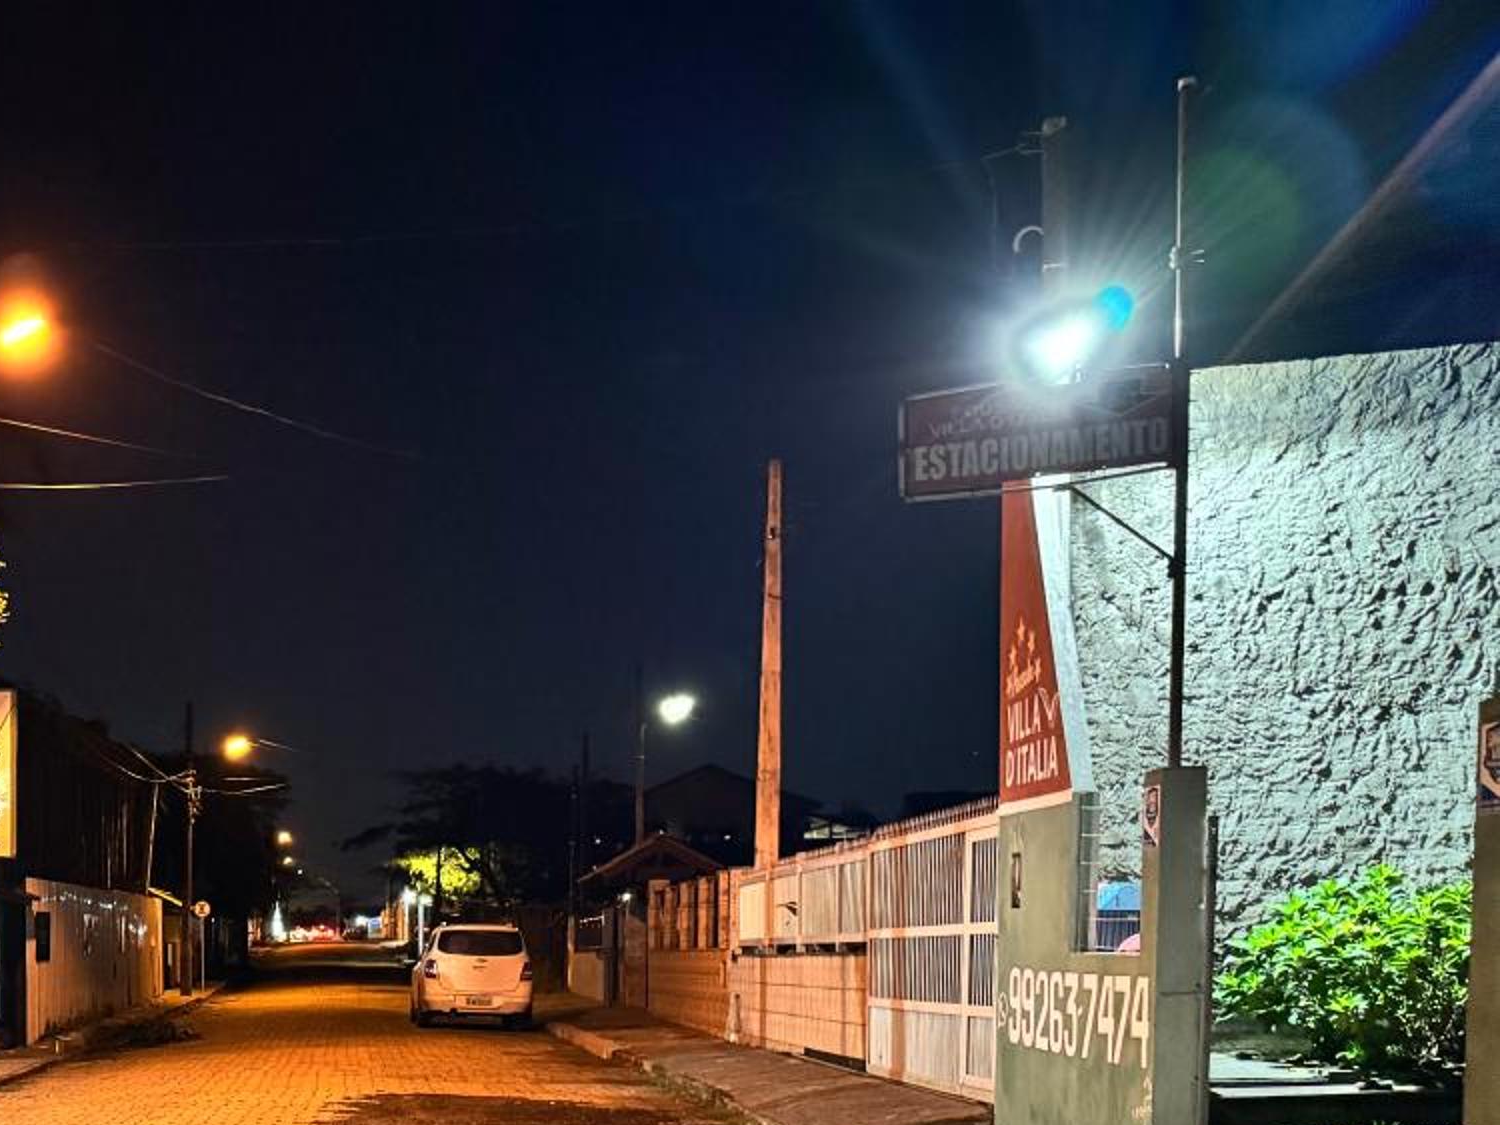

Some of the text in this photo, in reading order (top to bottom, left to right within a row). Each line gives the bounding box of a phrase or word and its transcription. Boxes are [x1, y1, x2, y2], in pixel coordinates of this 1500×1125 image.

[913, 417, 1169, 481] ESTACIONAMENTO
[1007, 692, 1041, 744] VILLA
[1005, 735, 1059, 788] D'ITALIA
[1008, 966, 1150, 1069] 99263-7474
